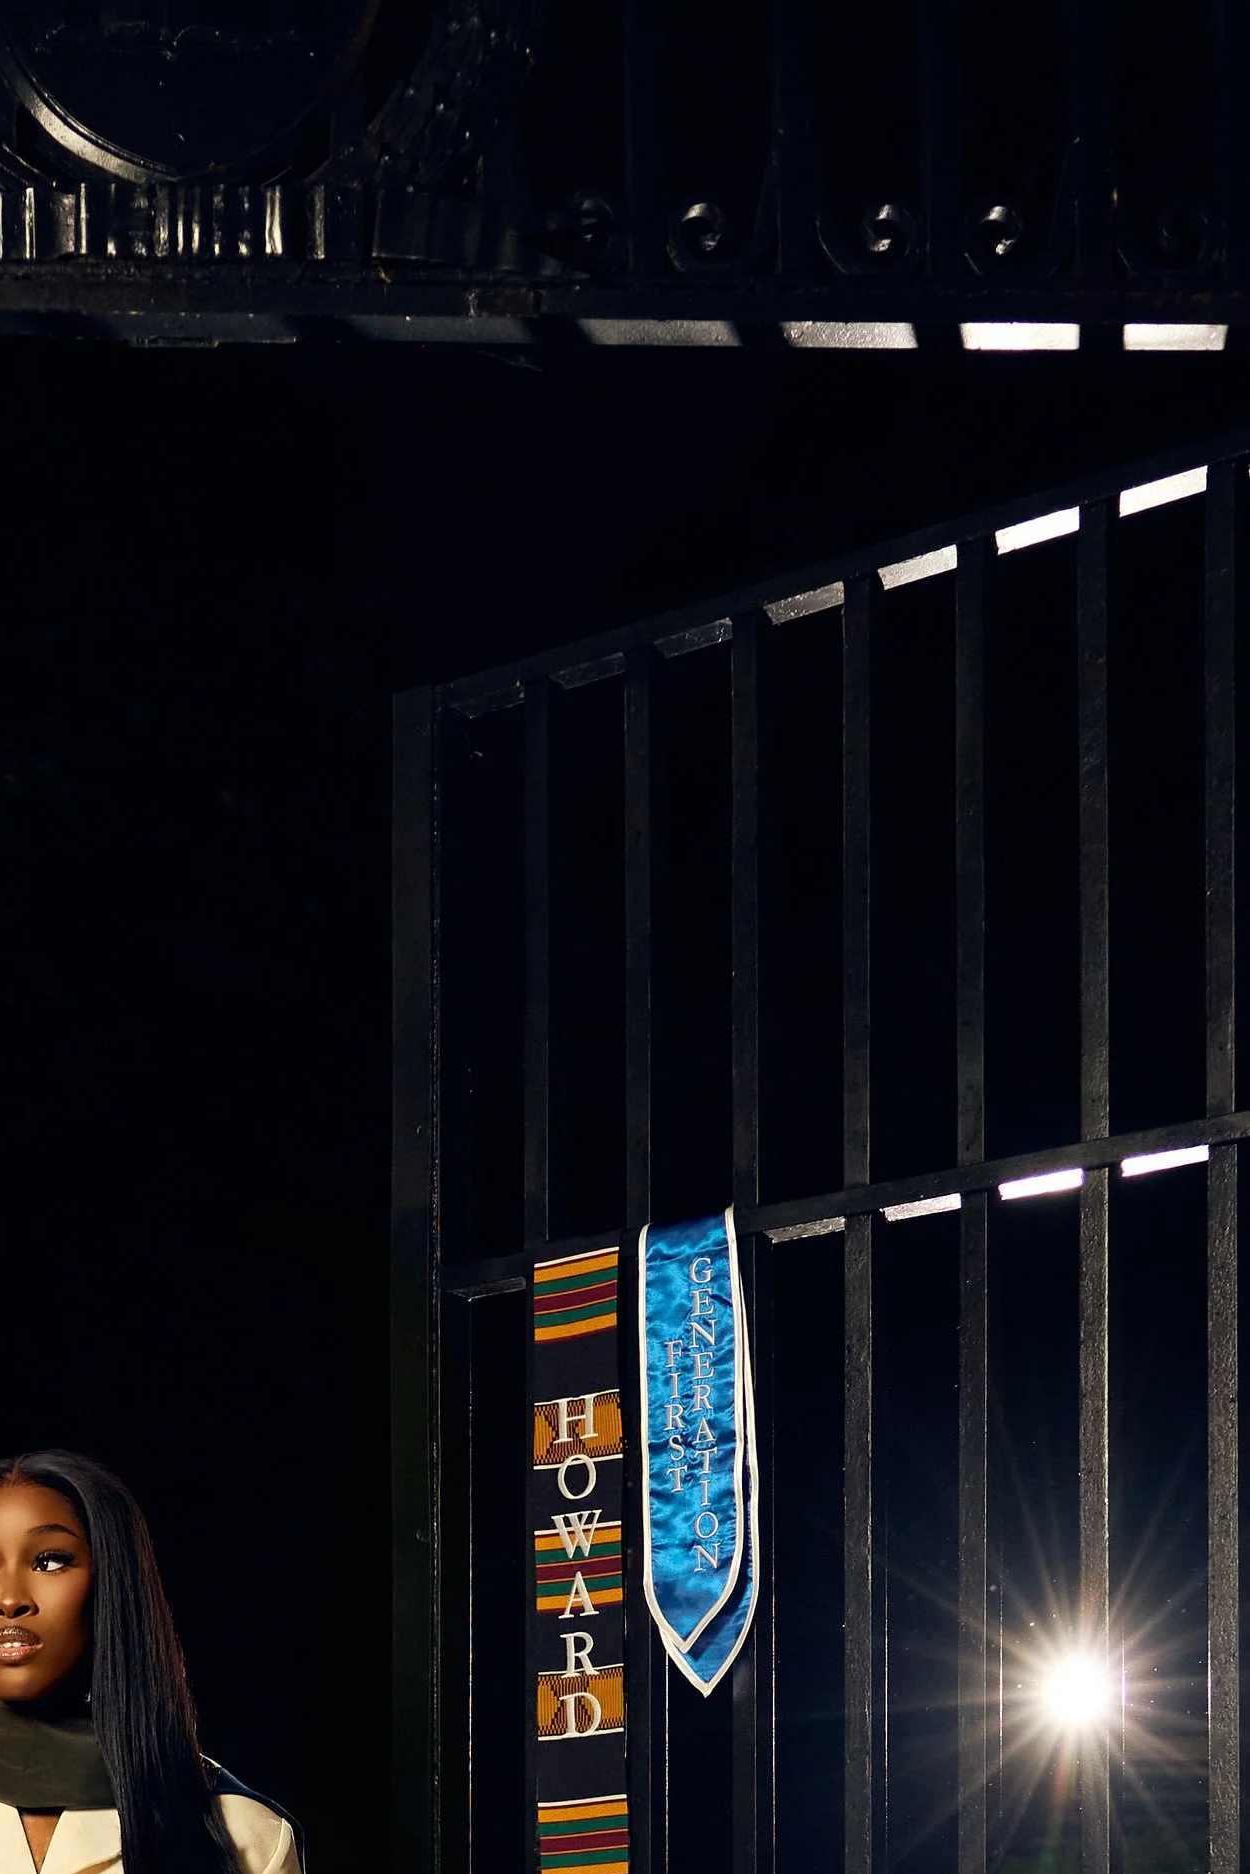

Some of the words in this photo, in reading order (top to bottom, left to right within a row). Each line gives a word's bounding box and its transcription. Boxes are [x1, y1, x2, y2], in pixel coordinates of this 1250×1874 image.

[551, 1393, 602, 1739] HOWARD
[664, 1339, 688, 1493] FIRST
[689, 1257, 720, 1573] GENERATION
